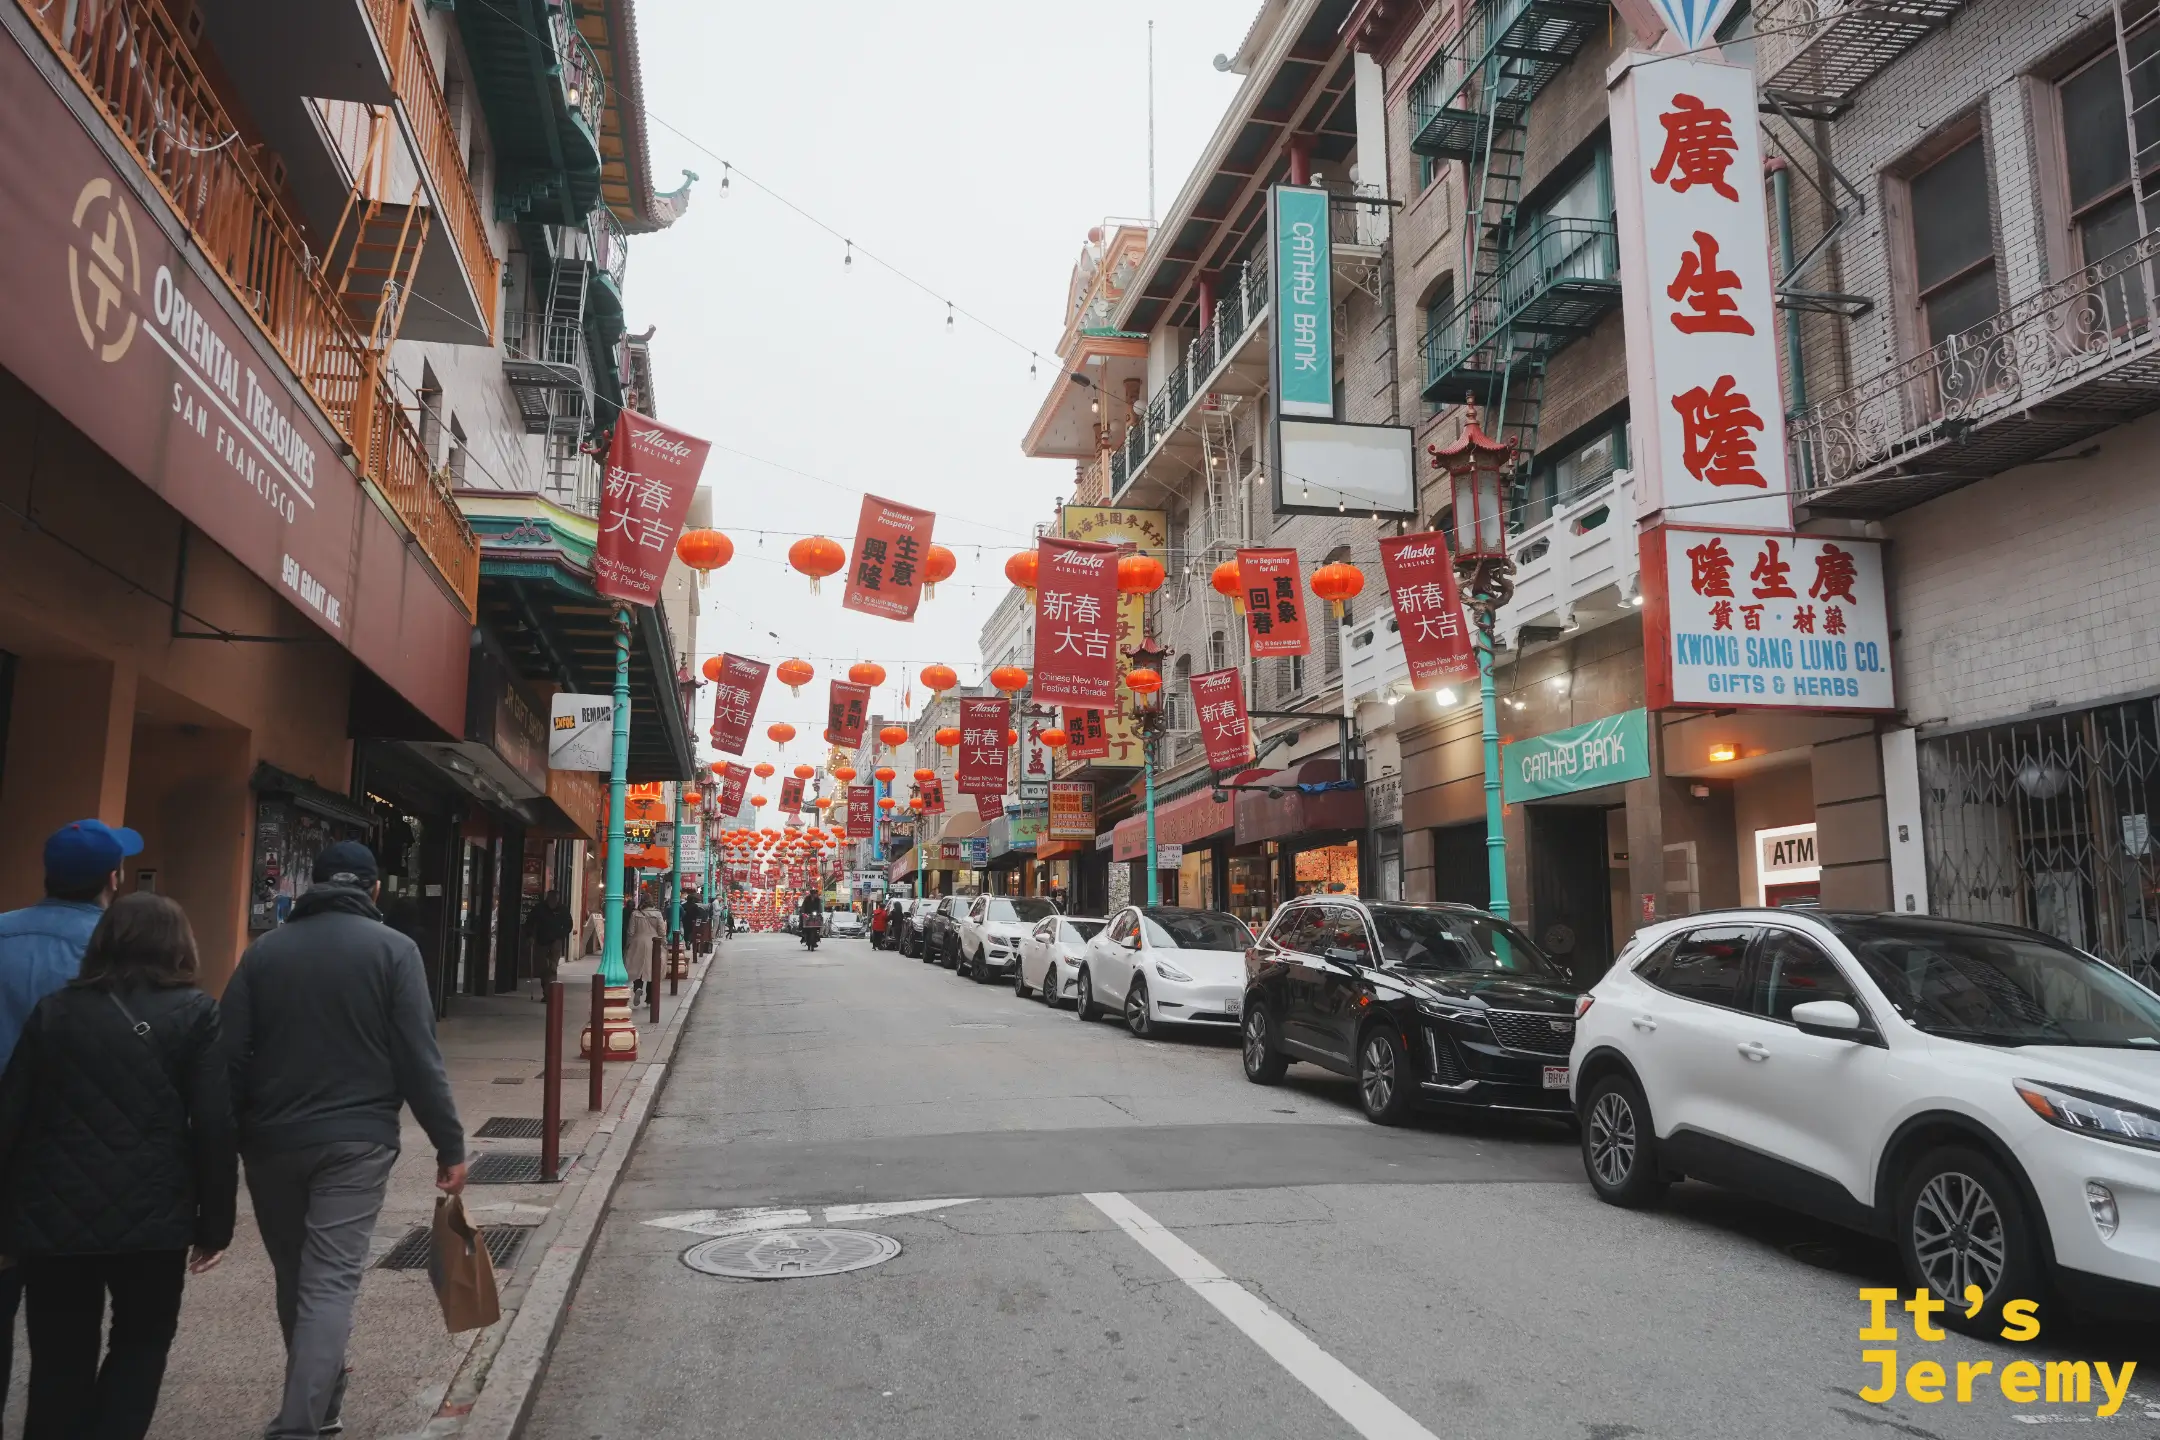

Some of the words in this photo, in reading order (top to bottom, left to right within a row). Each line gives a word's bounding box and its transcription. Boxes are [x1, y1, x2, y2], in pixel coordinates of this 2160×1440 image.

[1293, 222, 1315, 305] CATHAY
[1650, 93, 1767, 489] 廣生隆
[1293, 313, 1316, 372] BANK
[154, 265, 240, 408] ORIENTAL
[246, 367, 315, 489] TREASURES
[172, 382, 207, 438] SAN
[216, 424, 295, 524] FRANCISCO
[631, 429, 691, 458] Alaska
[632, 443, 681, 465] AIRLINES
[606, 465, 673, 513] 新春
[878, 516, 915, 532] Prosperity
[882, 508, 914, 522] Business
[605, 508, 673, 551] 大吉
[890, 534, 919, 587] 生意
[1053, 549, 1104, 569] Alaska
[1260, 557, 1290, 566] Beginning
[1394, 543, 1436, 561] Alaska
[614, 560, 636, 574] New
[640, 568, 658, 580] Year
[856, 537, 887, 591] 興隆
[1055, 566, 1099, 577] AIRLINES
[1399, 559, 1435, 569] AIRLINES
[282, 553, 300, 591] 950
[300, 569, 325, 613] GRANT
[325, 596, 341, 628] AVE.
[611, 571, 618, 581] &
[620, 575, 650, 591] Parade
[1043, 589, 1101, 624] 新春
[1273, 576, 1298, 623] 萬象
[1396, 582, 1444, 613] 新春
[1249, 588, 1273, 634] 回春
[1414, 611, 1459, 642] 大吉
[1054, 626, 1110, 658] 大吉
[1677, 633, 1739, 667] KWONG
[1746, 637, 1793, 669] SANG
[1800, 640, 1847, 672] LUNG
[1855, 641, 1885, 673] CO.
[729, 661, 760, 675] Alaska
[1412, 659, 1436, 669] Chinese
[1437, 656, 1451, 665] New
[1452, 653, 1468, 662] Year
[1039, 672, 1070, 683] Chinese
[1072, 675, 1090, 684] New
[1093, 676, 1110, 686] Year
[1041, 683, 1070, 693] Festival
[1072, 685, 1079, 694] &
[1080, 686, 1107, 696] Parade
[1200, 675, 1231, 689] Alaska
[1708, 673, 1765, 694] GIFTS
[1773, 675, 1785, 694] &
[1794, 677, 1859, 697] HERBS
[716, 683, 750, 706] 新春
[717, 704, 751, 727] 大吉
[969, 703, 1000, 713] Alaska
[1201, 700, 1237, 722] 新春
[963, 728, 998, 746] 新春
[1213, 717, 1246, 740] 大吉
[971, 748, 1004, 765] 大吉
[1522, 744, 1577, 783] CATHAY
[1582, 732, 1625, 771] BANK
[850, 802, 868, 811] 新春
[853, 813, 871, 822] 大吉
[1773, 838, 1814, 866] ATM
